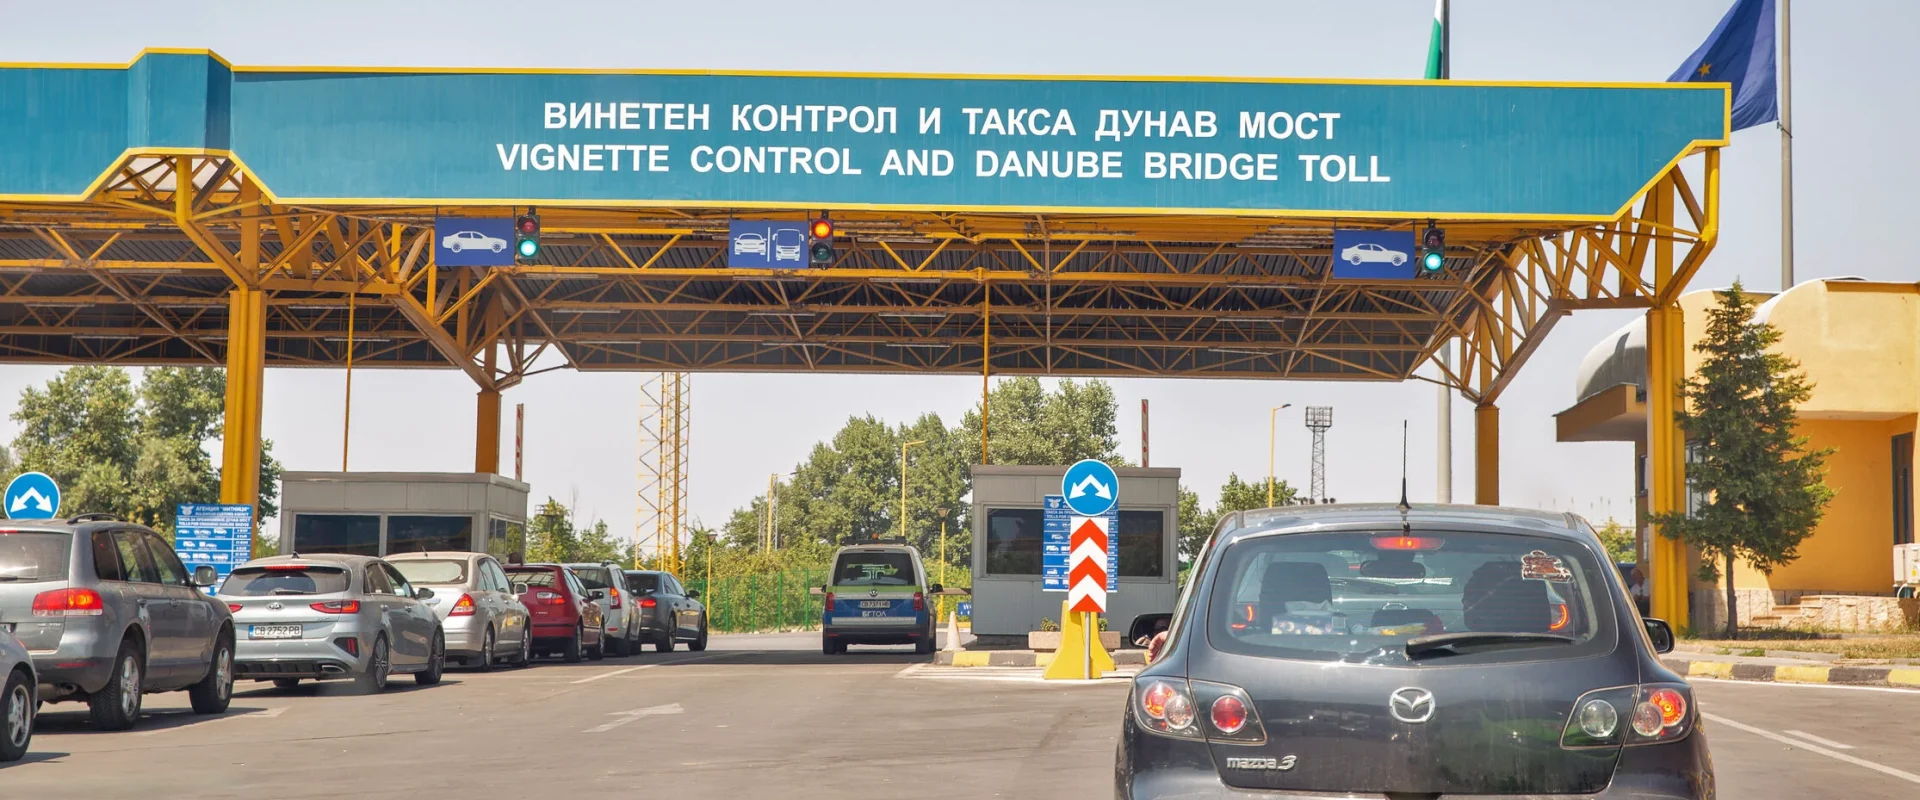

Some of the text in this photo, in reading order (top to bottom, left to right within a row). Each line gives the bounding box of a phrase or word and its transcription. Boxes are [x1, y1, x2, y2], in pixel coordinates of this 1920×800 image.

[544, 102, 1341, 142] ВИНЕТЕН КОНТРОЛ И ТАКСА ДУНАВ МОСТ
[496, 143, 1391, 183] VIGNETTE CONTROL AND DANUBE BRIDGE TOLL
